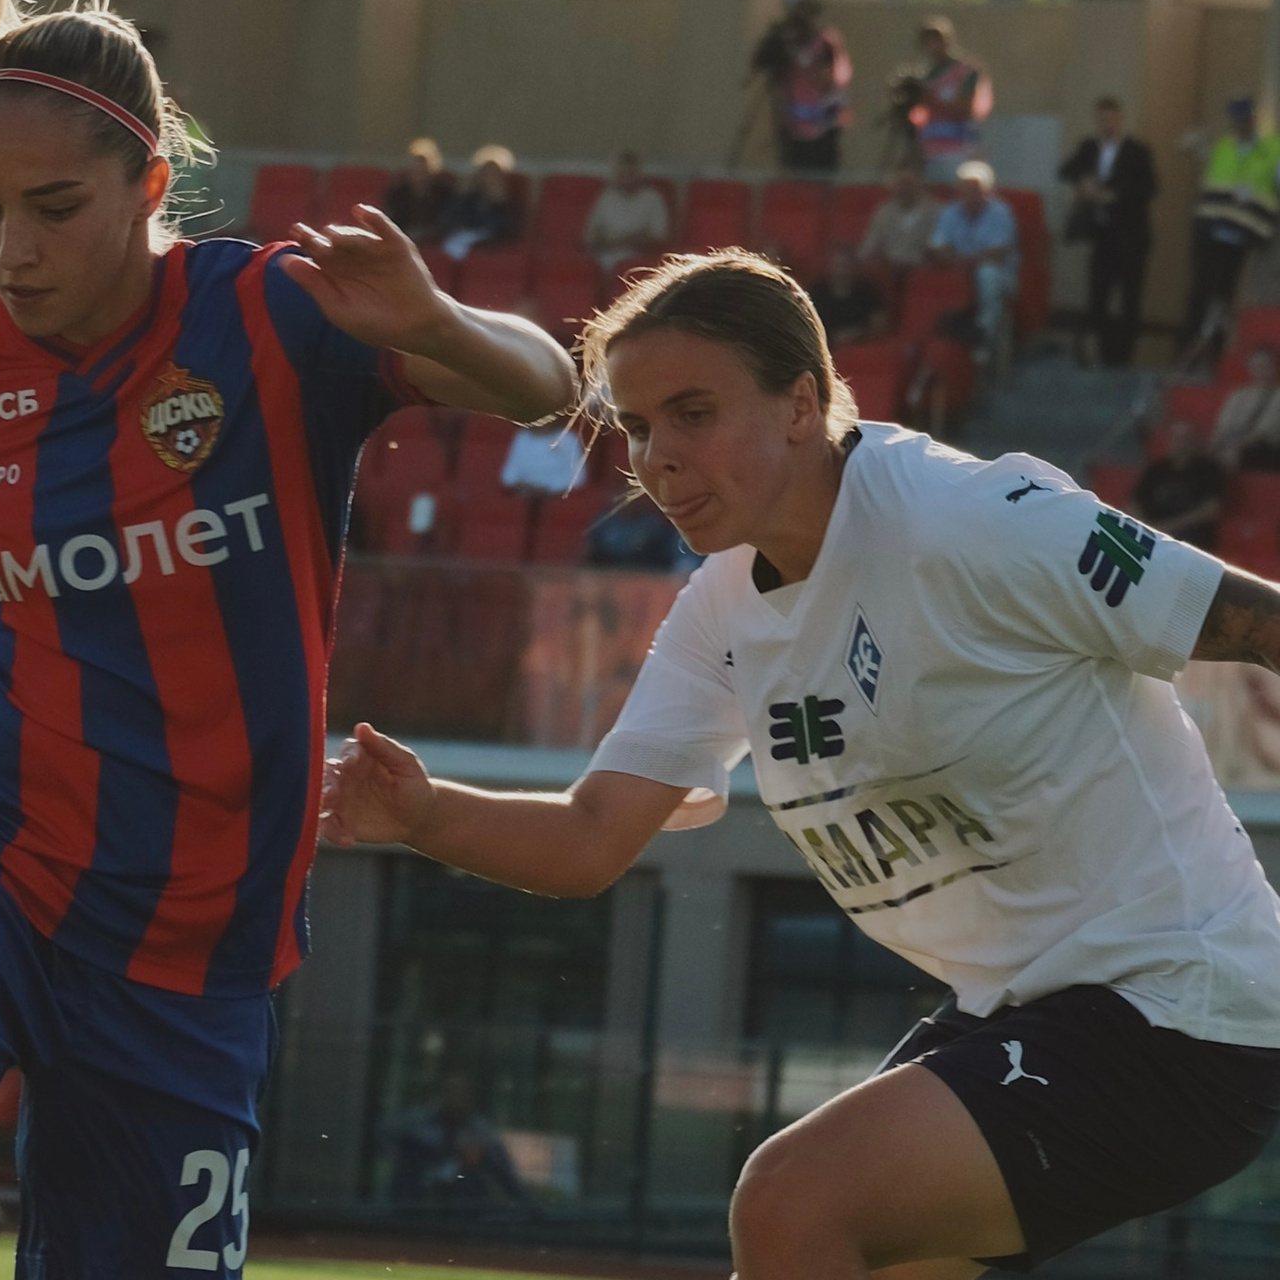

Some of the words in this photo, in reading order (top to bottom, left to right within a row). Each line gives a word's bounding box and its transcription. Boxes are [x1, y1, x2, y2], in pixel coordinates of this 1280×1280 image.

[149, 392, 221, 434] ЦСКА
[784, 793, 995, 891] МАРА
[166, 1148, 250, 1272] 25
